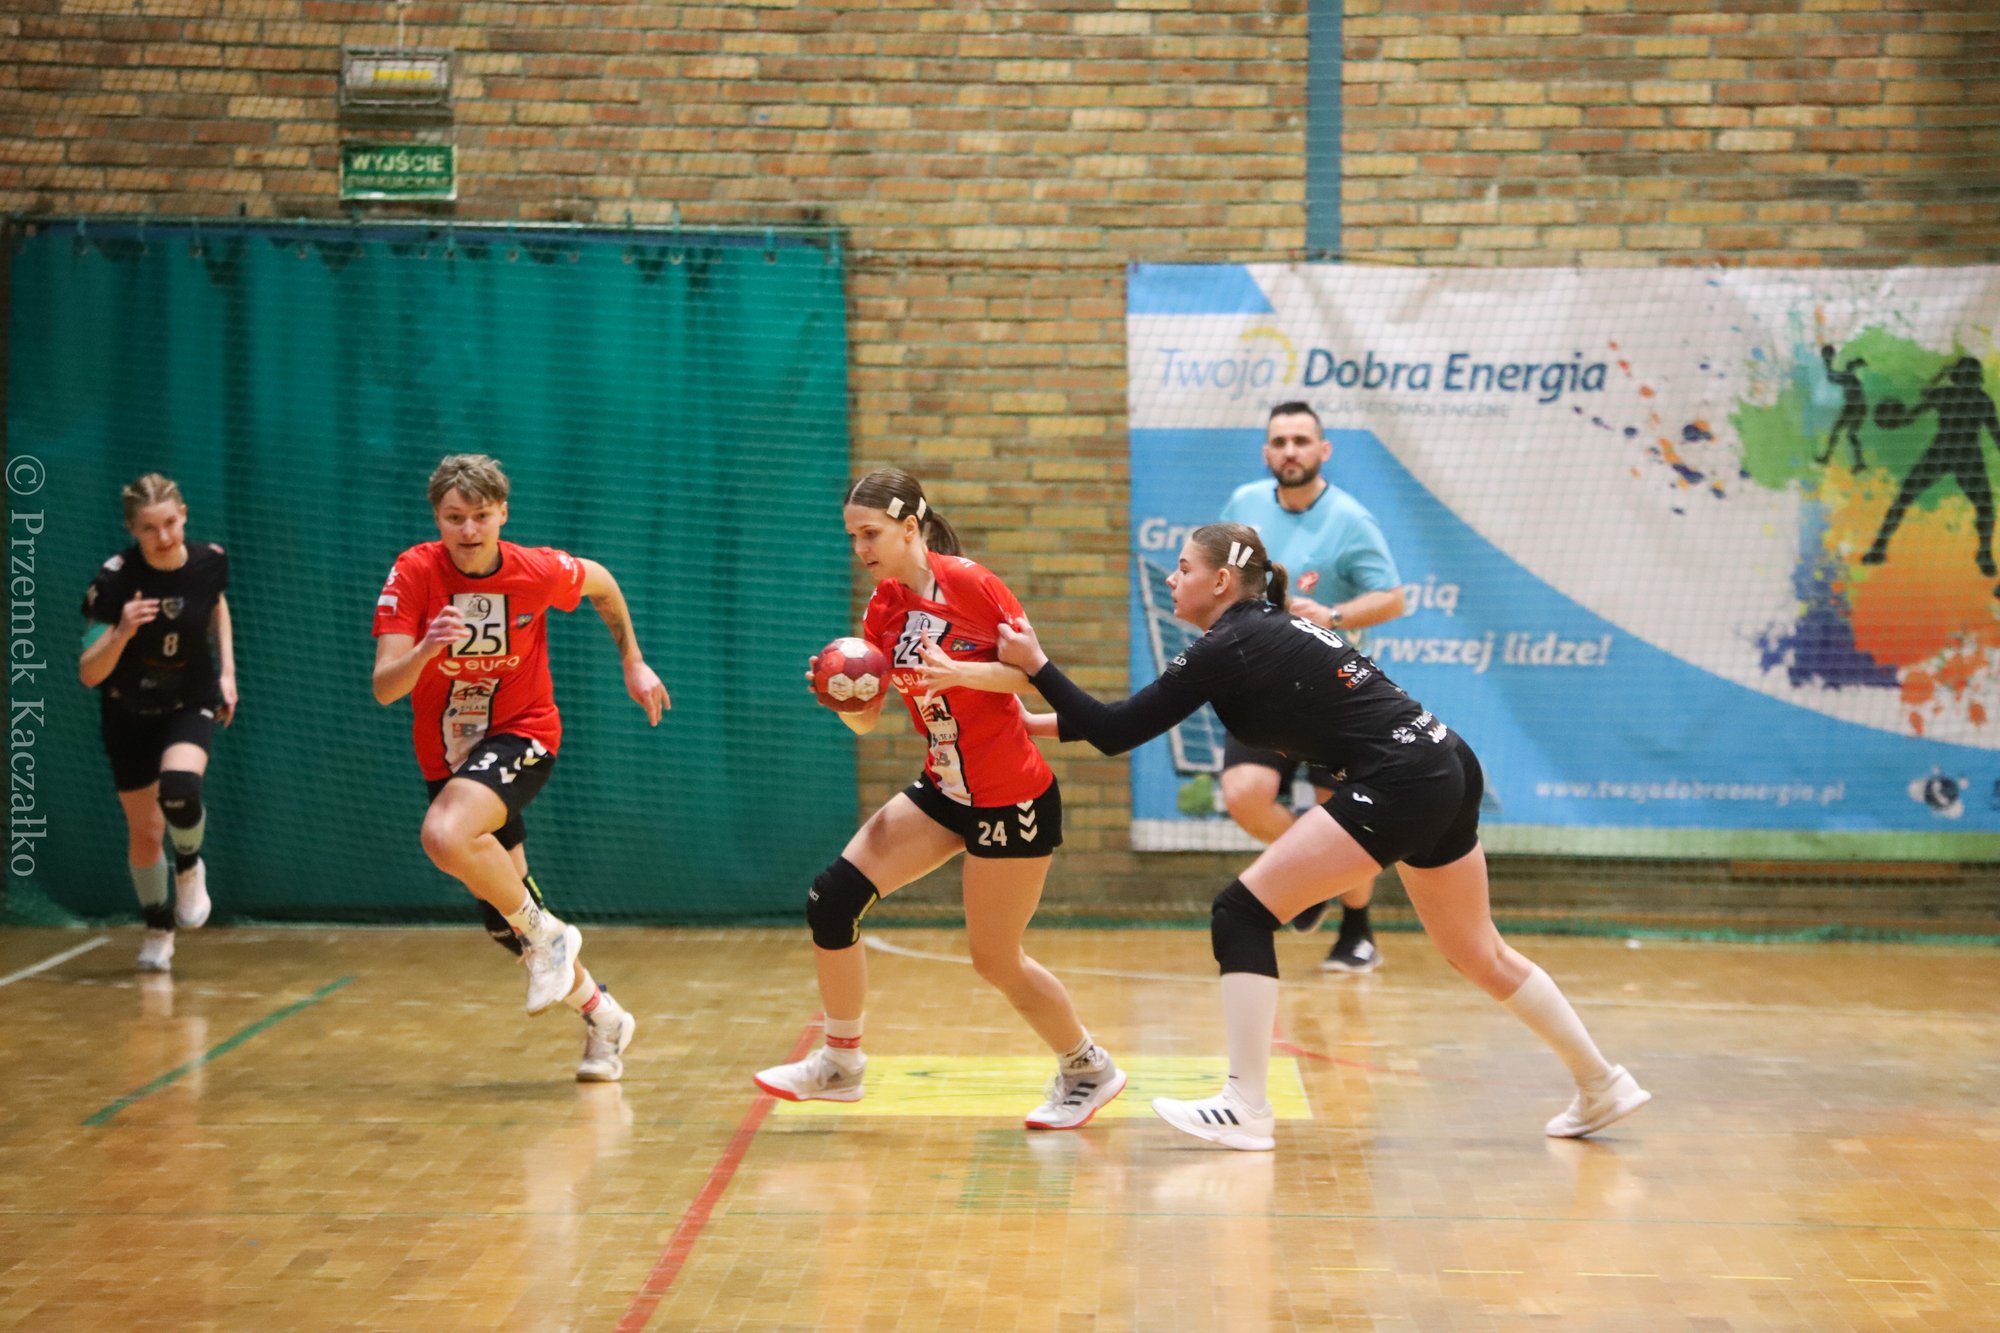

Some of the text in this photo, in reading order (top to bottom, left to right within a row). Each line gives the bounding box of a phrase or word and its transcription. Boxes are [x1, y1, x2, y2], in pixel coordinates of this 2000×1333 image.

[352, 150, 445, 172] WYJŚCIE
[1157, 347, 1608, 403] Twoja Dobra Energia
[163, 632, 180, 657] 8
[457, 623, 502, 655] 25
[1370, 629, 1613, 674] rwszej lidze!
[464, 656, 520, 671] euro
[978, 820, 1007, 846] 24
